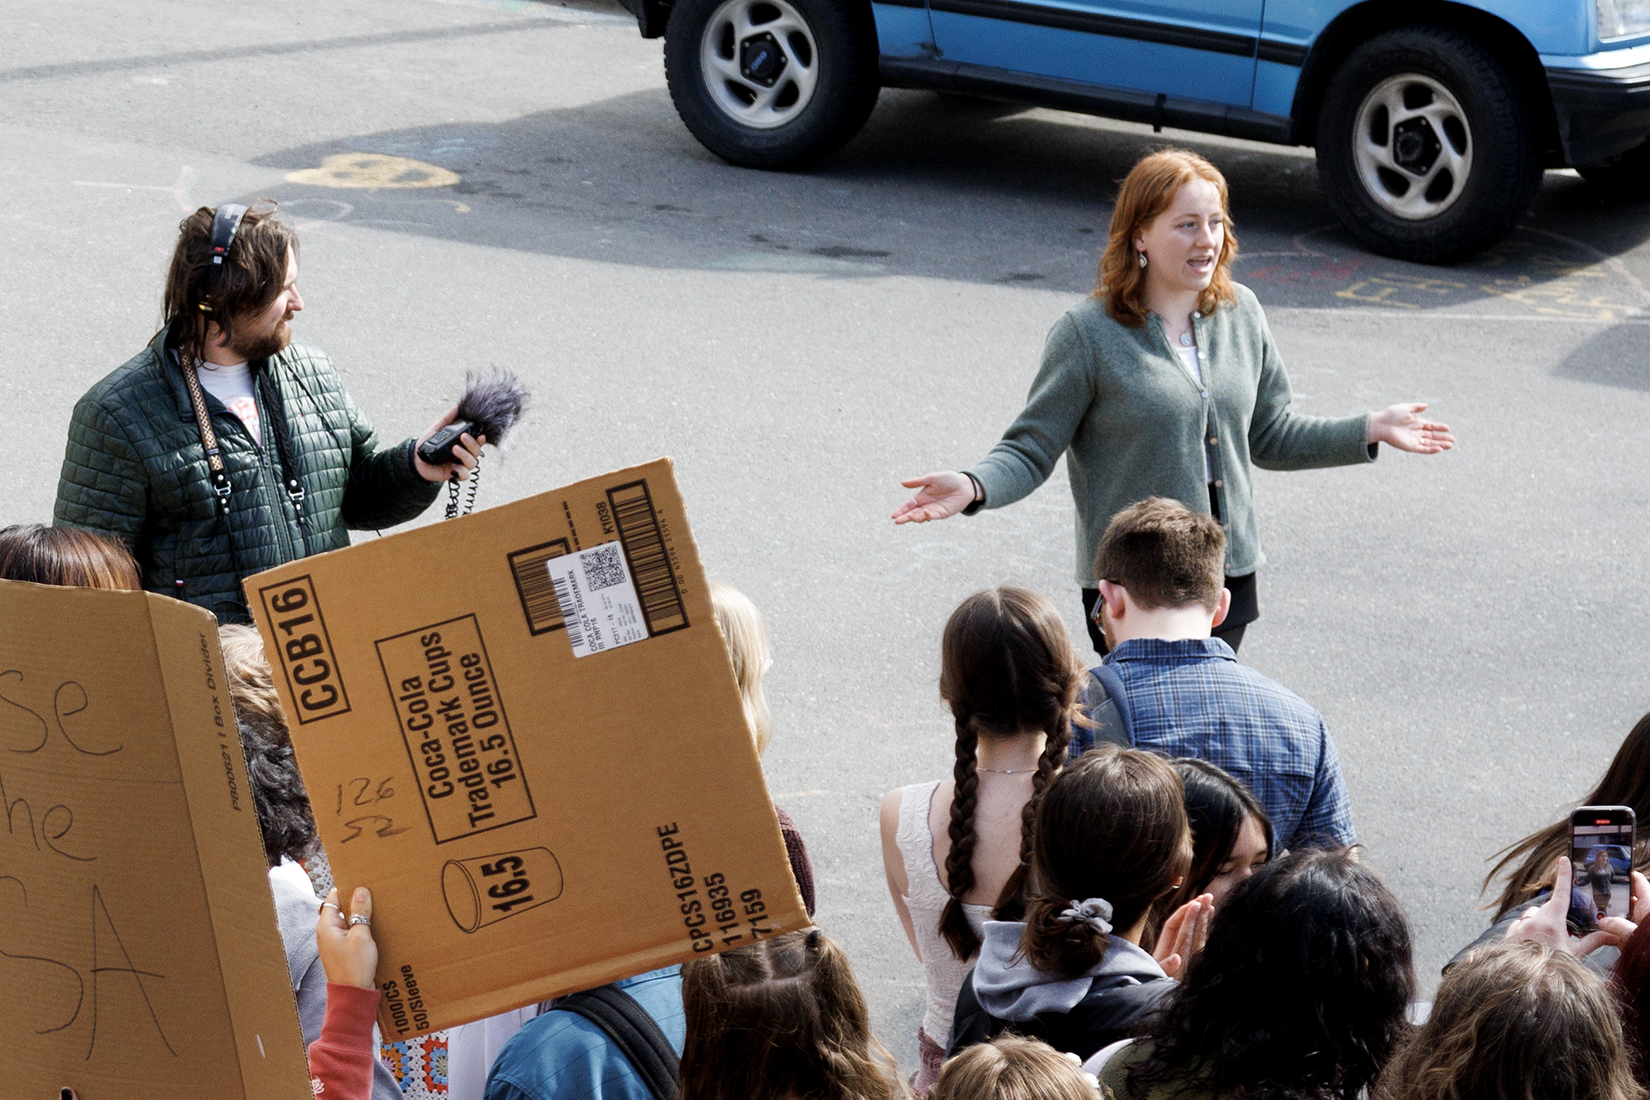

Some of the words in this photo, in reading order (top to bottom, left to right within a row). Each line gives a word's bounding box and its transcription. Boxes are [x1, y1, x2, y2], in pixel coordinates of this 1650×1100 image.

[596, 501, 615, 535] K1038
[567, 569, 586, 612] TRADEMARK
[272, 587, 339, 711] CCB16
[581, 613, 592, 632] COLA
[587, 634, 598, 652] COCA
[199, 631, 217, 690] Divider
[421, 631, 456, 693] Cups
[212, 694, 224, 727] Box
[460, 652, 500, 729] Ounce
[400, 675, 455, 799] Coca-Cola
[437, 696, 496, 828] Trademark
[479, 733, 517, 789] 16.5
[481, 855, 534, 912] 16.5
[656, 822, 714, 953] CPCS16ZDPE
[704, 872, 743, 946] 116935
[740, 888, 773, 939] 7159
[382, 980, 411, 1036] 1000/CS
[401, 964, 430, 1031] 50/Sleeve
